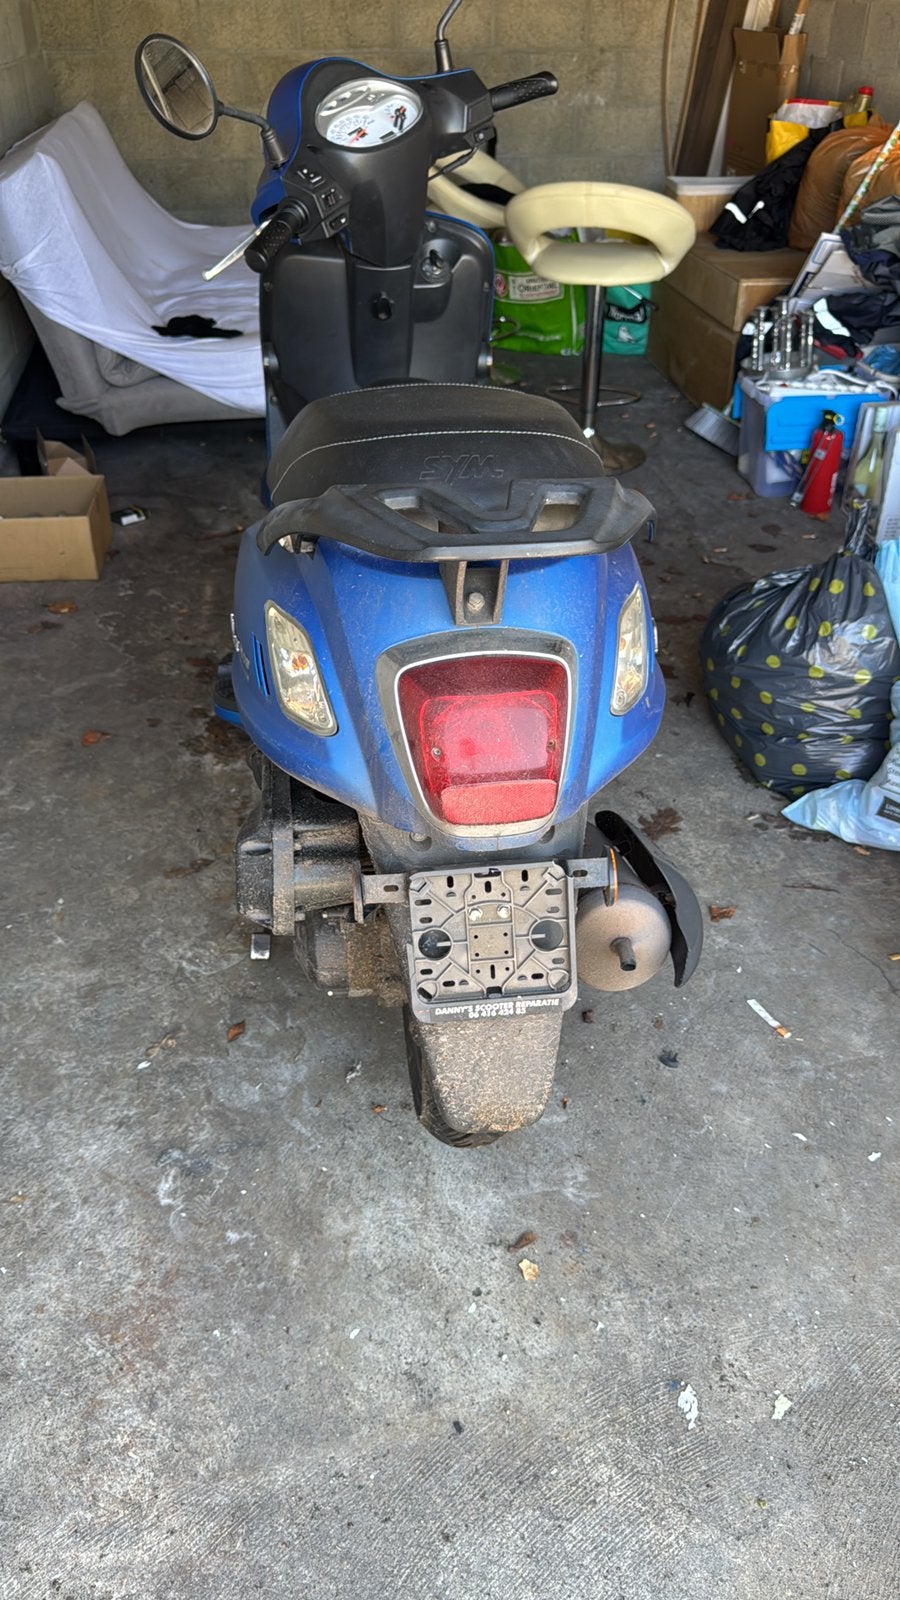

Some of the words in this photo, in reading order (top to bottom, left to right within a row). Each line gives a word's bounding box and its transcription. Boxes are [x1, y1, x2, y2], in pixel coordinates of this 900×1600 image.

[419, 454, 504, 486] SYM
[435, 1006, 473, 1016] DANNY'S
[475, 1001, 514, 1012] SCOOTER
[515, 999, 560, 1009] REPARATIE
